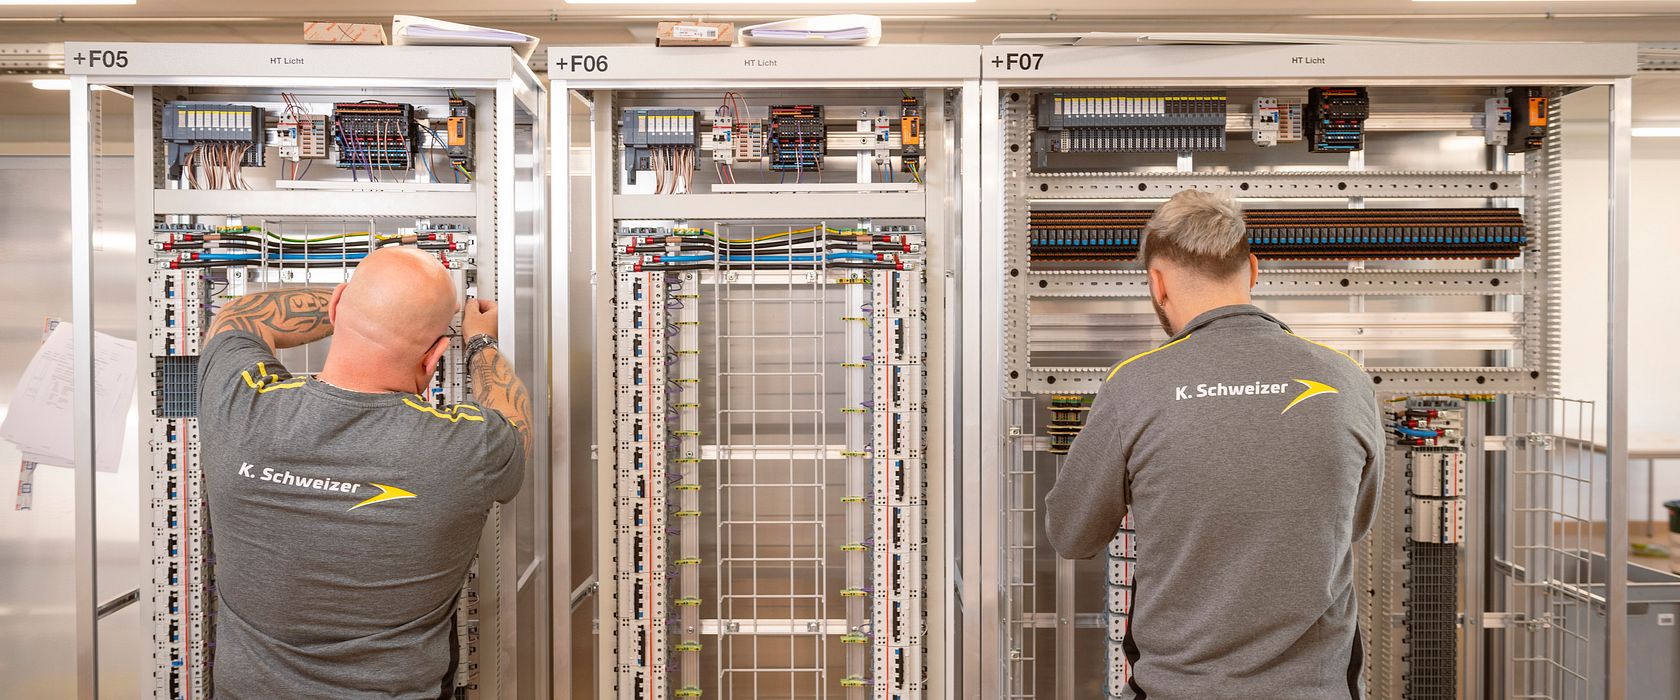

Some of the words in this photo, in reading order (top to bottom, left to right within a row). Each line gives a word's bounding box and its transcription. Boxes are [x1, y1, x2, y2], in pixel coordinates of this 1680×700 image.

[73, 50, 128, 68] +F05
[270, 57, 282, 65] HT
[284, 57, 305, 65] Licht
[556, 55, 608, 72] +F06
[744, 59, 756, 67] HT
[757, 59, 777, 67] Licht
[991, 53, 1044, 70] +F07
[1291, 56, 1304, 64] HT
[1305, 56, 1325, 65] Licht
[1175, 385, 1193, 401] K.
[1196, 381, 1289, 398] Schweizer
[238, 462, 256, 479] K.
[260, 467, 361, 494] Schweizer
